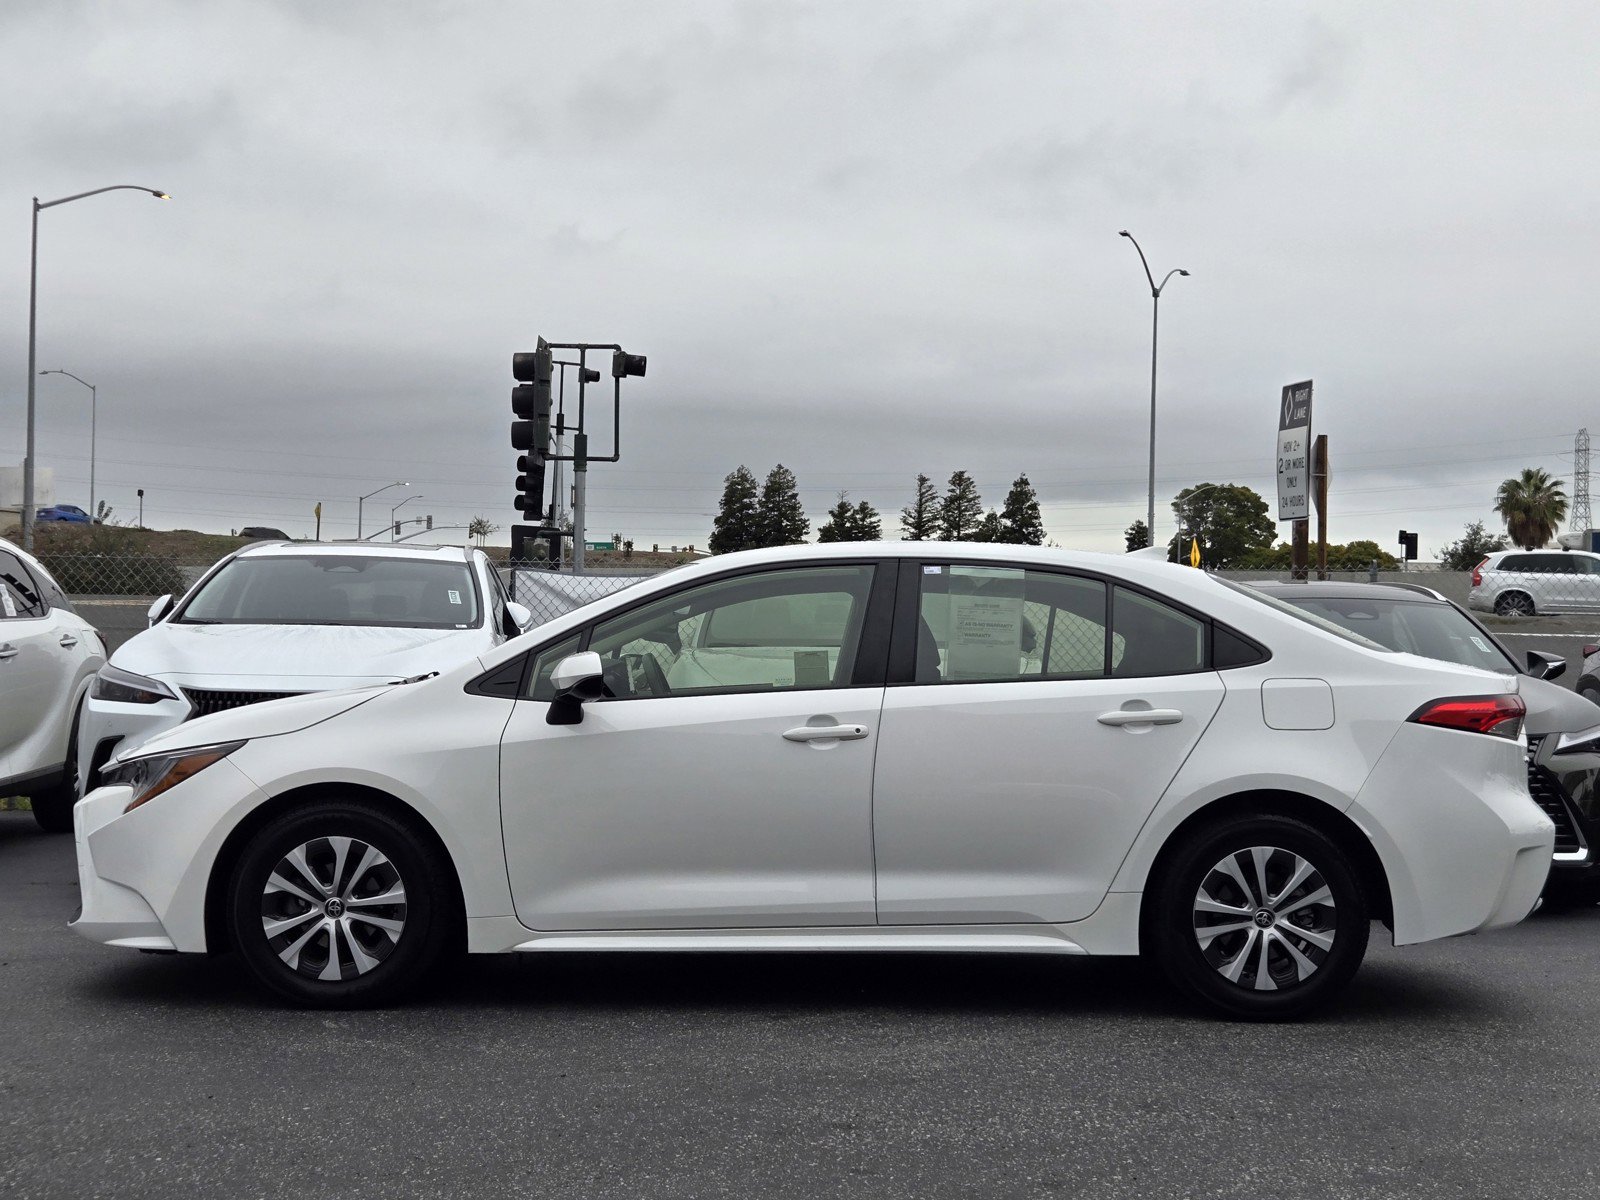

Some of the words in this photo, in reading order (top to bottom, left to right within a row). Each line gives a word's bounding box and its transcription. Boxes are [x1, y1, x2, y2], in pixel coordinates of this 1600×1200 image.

[1295, 388, 1309, 402] RIGHT
[1294, 406, 1306, 419] LANE
[1283, 441, 1292, 453] HOV
[1279, 457, 1284, 474] 2
[1285, 459, 1291, 471] OR
[1292, 457, 1304, 469] MORE
[1287, 476, 1298, 488] ONLY
[1282, 496, 1289, 508] 24
[1290, 495, 1304, 507] HOURS
